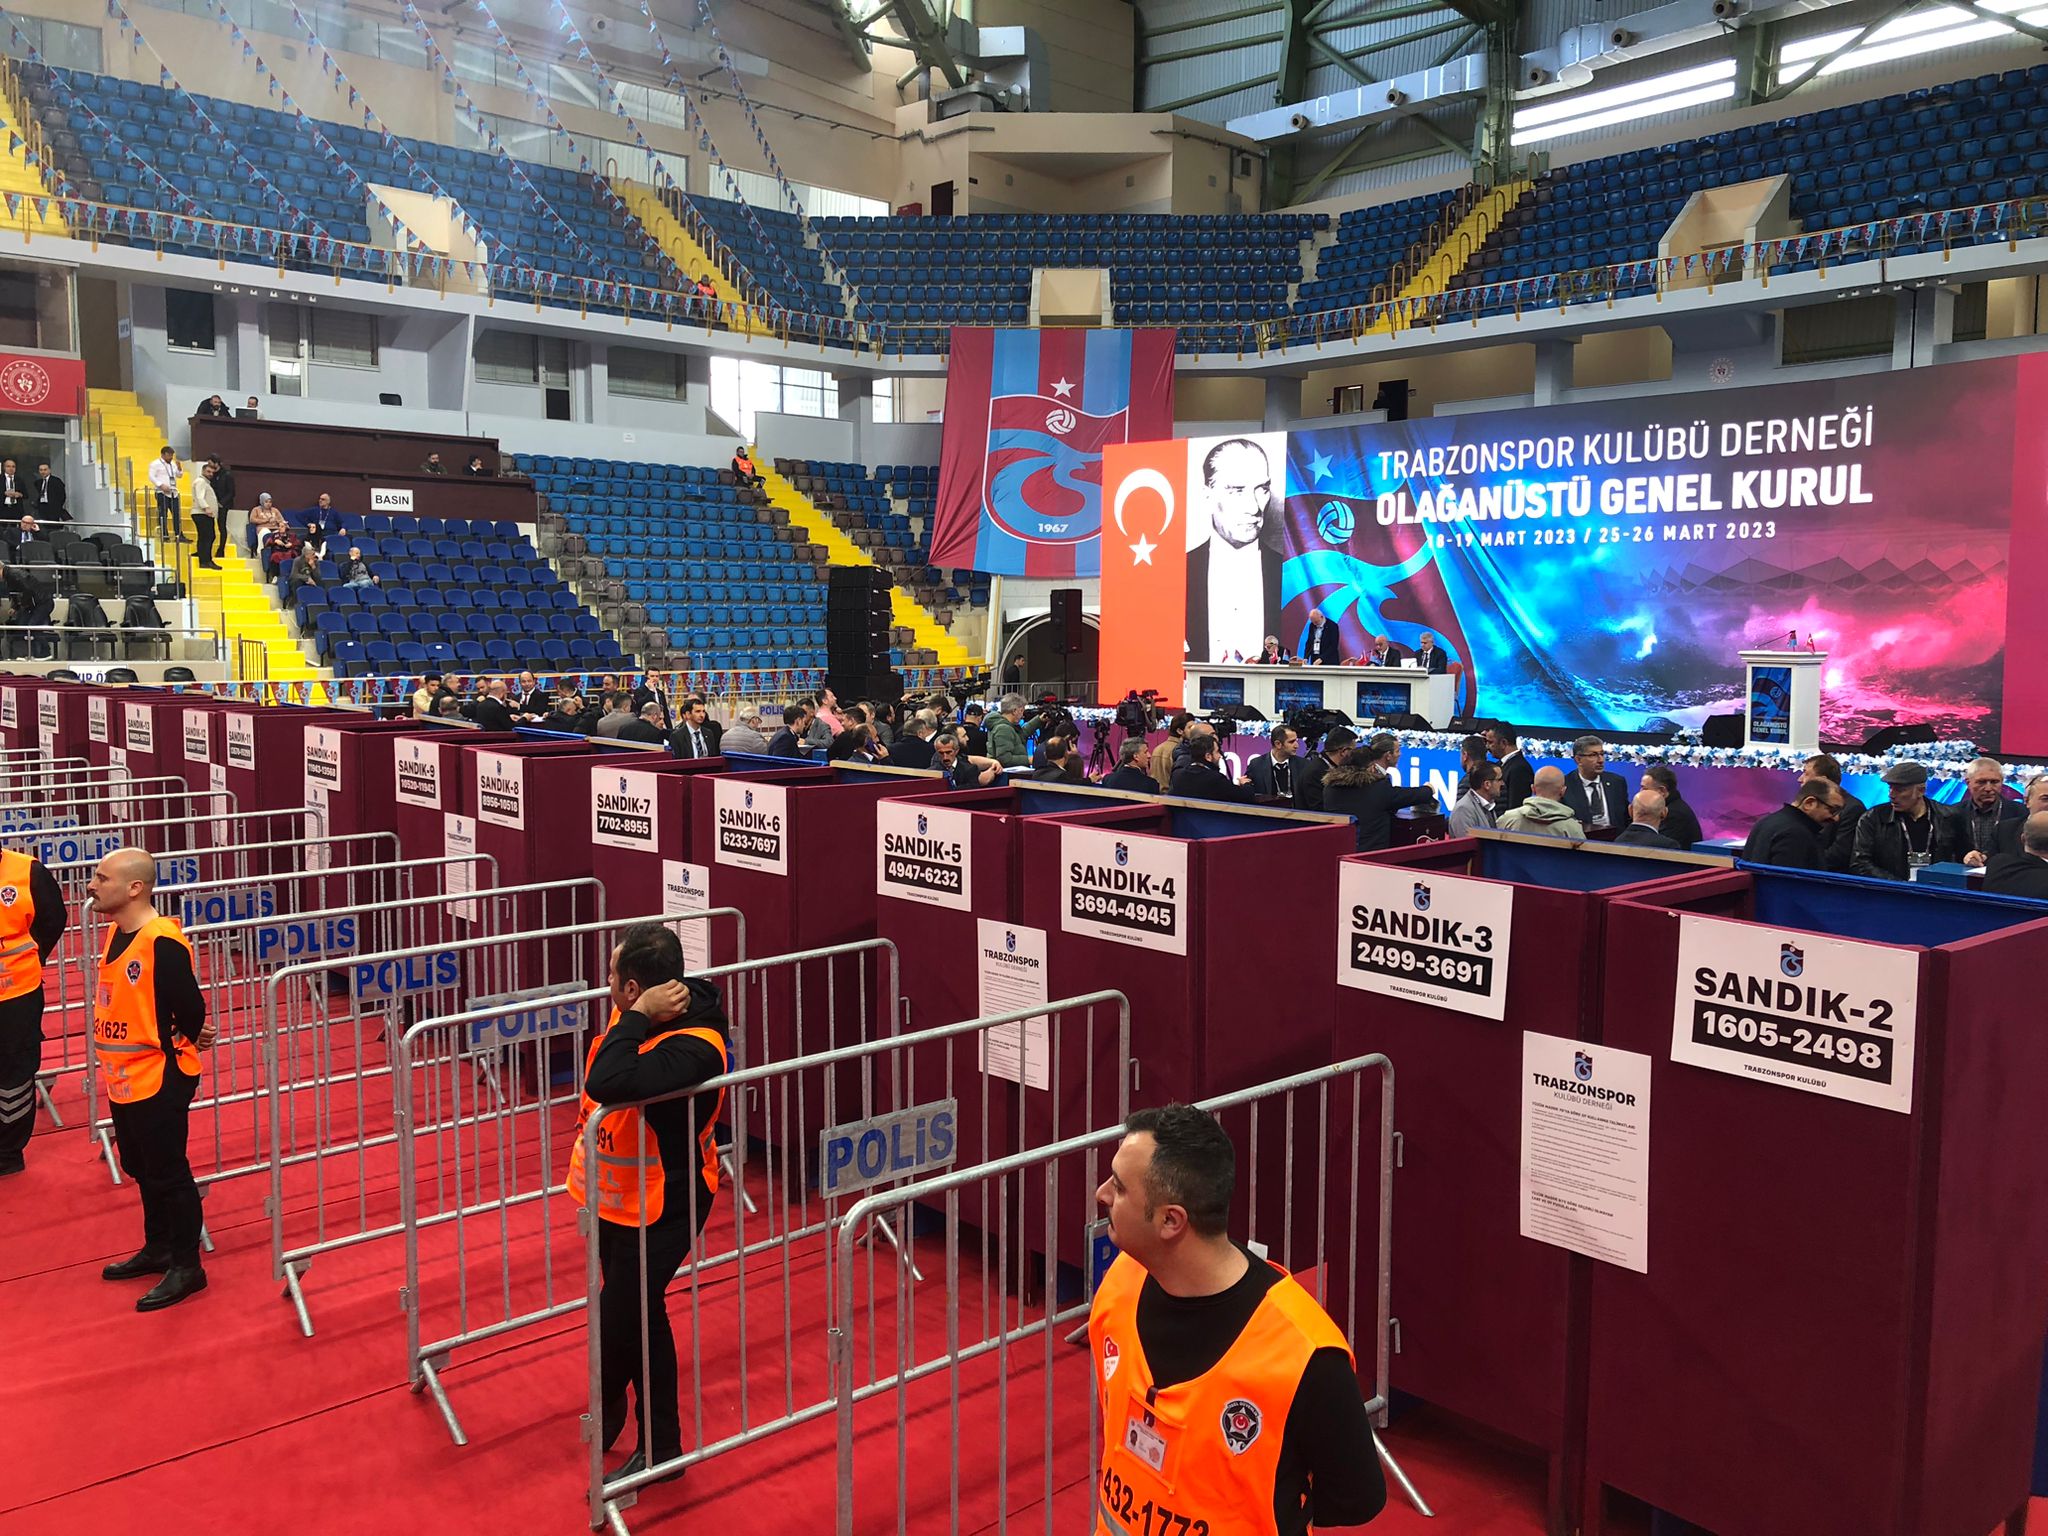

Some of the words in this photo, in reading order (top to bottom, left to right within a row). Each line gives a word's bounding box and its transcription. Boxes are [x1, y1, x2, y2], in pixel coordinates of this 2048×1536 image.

[1378, 436, 1574, 480] TRABZONSPOR
[1584, 420, 1709, 465] KULÜBÜ
[1721, 405, 1873, 456] DERNEĞİ
[375, 494, 410, 505] BASIN
[1376, 475, 1591, 525] OLAĞANÜSTÜ
[1600, 473, 1723, 515] GENEL
[1732, 464, 1873, 509] KURUL
[1038, 523, 1069, 533] 1967
[1481, 530, 1527, 546] MART
[1534, 528, 1575, 545] 2023
[1584, 528, 1592, 544] /
[1599, 526, 1654, 543] 25-26
[1664, 523, 1717, 541] MART
[1726, 521, 1776, 540] 2023
[228, 731, 251, 744] SANDIK-11
[306, 745, 338, 761] SANDIK-10
[398, 759, 435, 778] SANDIK-9
[400, 778, 435, 794] 10520-11942
[480, 775, 520, 795] SANDIK-8
[482, 794, 518, 812] 8956-10518
[597, 793, 651, 815] SANDIK-7
[599, 815, 649, 835] 7702-8955
[719, 807, 780, 832] SANDIK-6
[722, 831, 777, 854] 6233-7697
[884, 833, 962, 863] SANDIK-5
[888, 860, 959, 888] 4947-6232
[1070, 862, 1176, 899] SANDIK-4
[667, 883, 705, 898] TRABZONSPOR
[1074, 892, 1172, 927] 3694-4945
[1352, 904, 1493, 953] SANDIK-3
[984, 948, 1040, 969] TRABZONSPOR
[1357, 941, 1484, 987] 2499-3691
[1693, 967, 1894, 1033] SANDIK-2
[1702, 1010, 1882, 1069] 1605-2498
[1743, 1064, 1796, 1082] TRABZONSPOR
[1797, 1074, 1828, 1089] KULÜBÜ
[1532, 1073, 1636, 1107] TRABZONSPOR
[1553, 1091, 1581, 1104] KULÜBÜ
[1583, 1097, 1613, 1111] DERNEĞİ
